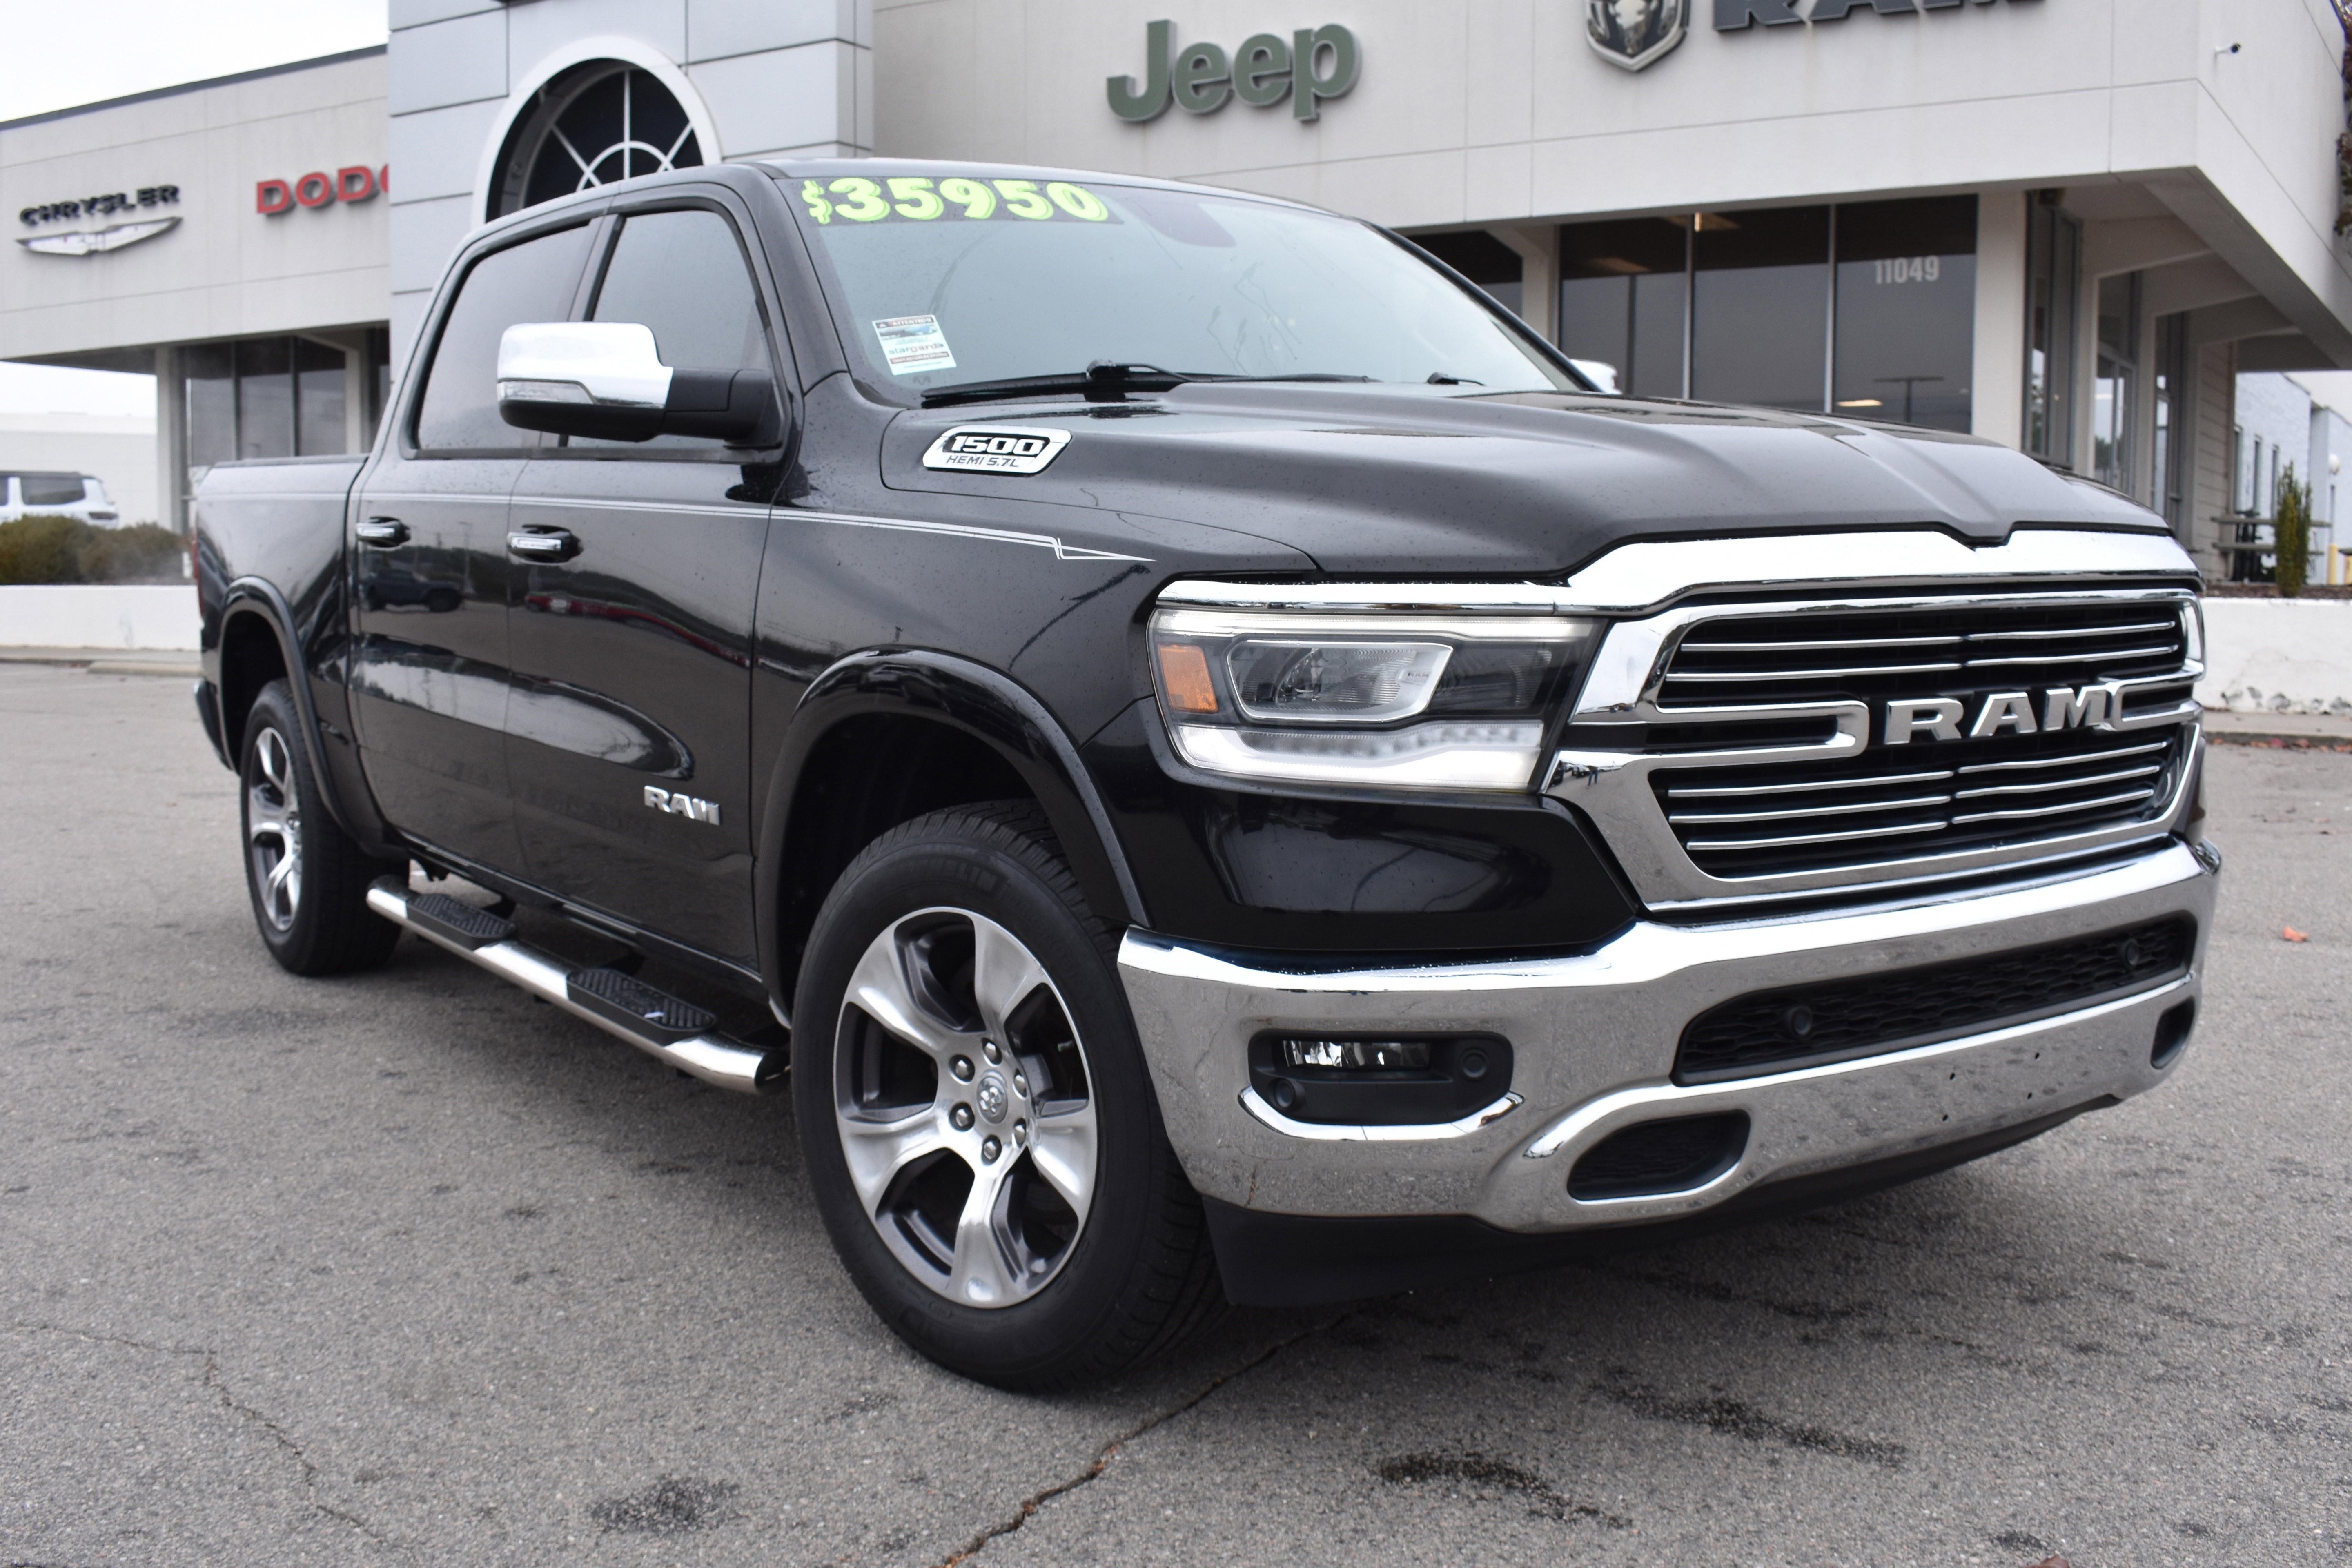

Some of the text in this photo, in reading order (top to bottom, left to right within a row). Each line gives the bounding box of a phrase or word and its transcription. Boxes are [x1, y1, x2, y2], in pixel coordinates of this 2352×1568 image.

[1106, 18, 1362, 122] Jeep
[19, 184, 180, 226] CHRYSLER
[257, 164, 389, 217] DOD
[802, 178, 1108, 225] $35950
[1875, 255, 1940, 285] 11049
[946, 455, 1018, 467] HEMI 5.7L
[951, 435, 1045, 455] 1500
[1884, 685, 2107, 745] RAM
[644, 785, 720, 826] RAM
